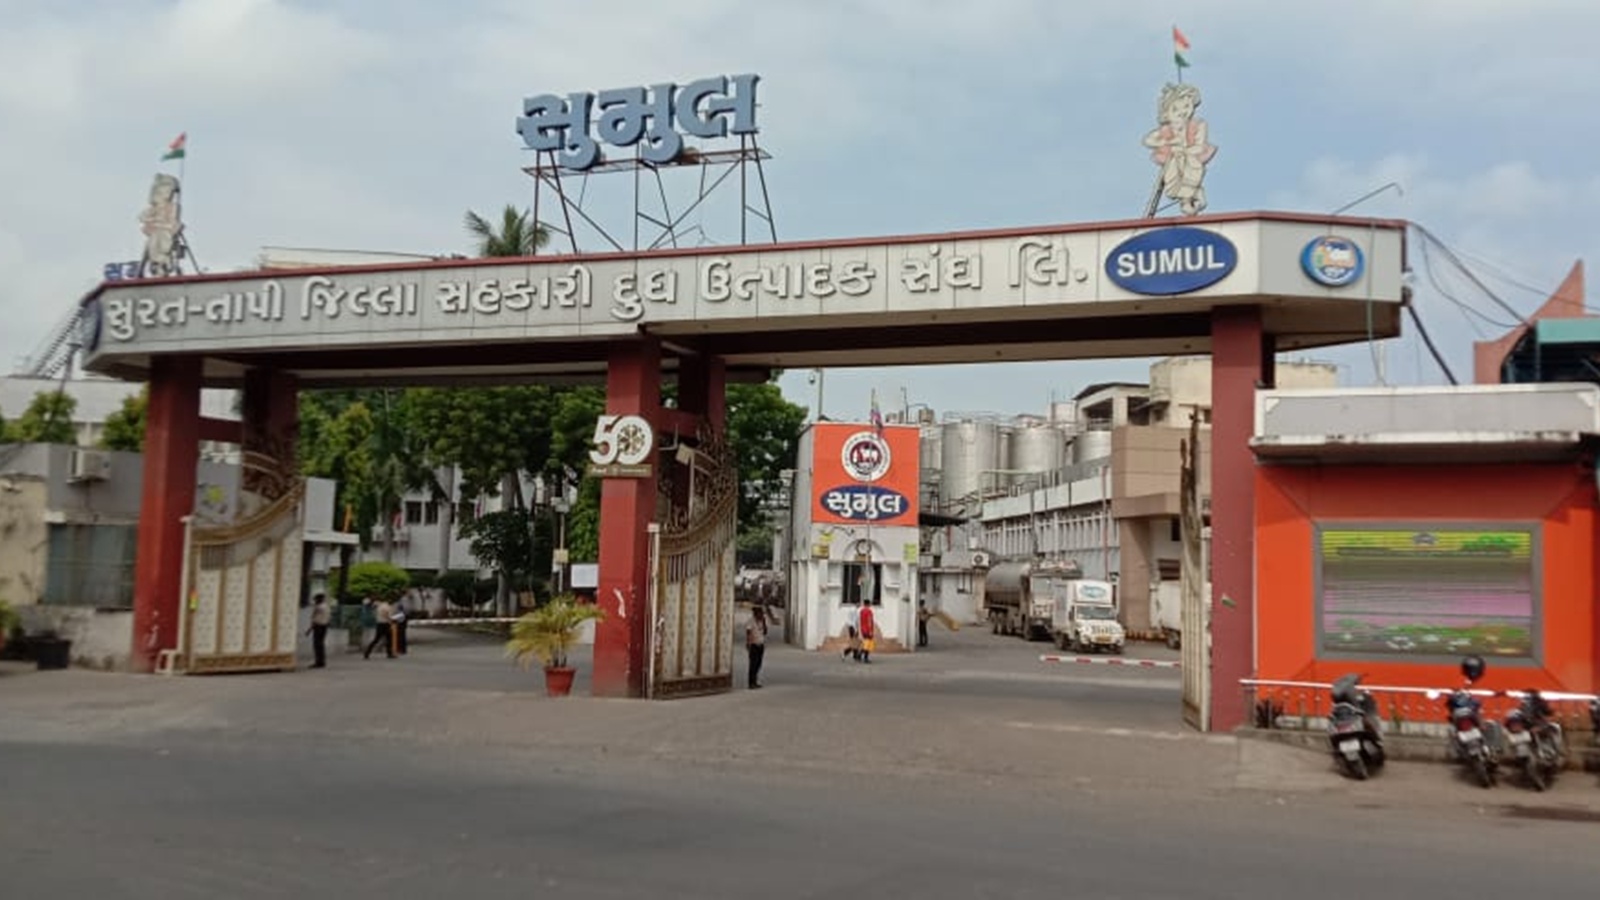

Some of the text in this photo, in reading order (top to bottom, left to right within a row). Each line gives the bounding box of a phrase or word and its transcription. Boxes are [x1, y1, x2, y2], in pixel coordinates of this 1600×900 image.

[516, 74, 760, 170] સુમુલ
[1116, 244, 1226, 279] SUMUL
[106, 279, 284, 341] સુરત-તાપી
[301, 275, 418, 320] જિલ્લા
[436, 263, 593, 314] સહકારી
[700, 257, 876, 303] ઉત્પાદક
[900, 244, 983, 294] સંઘ
[1007, 237, 1089, 289] લિ.
[588, 414, 653, 466] 50
[826, 491, 902, 519] સુમુલ
